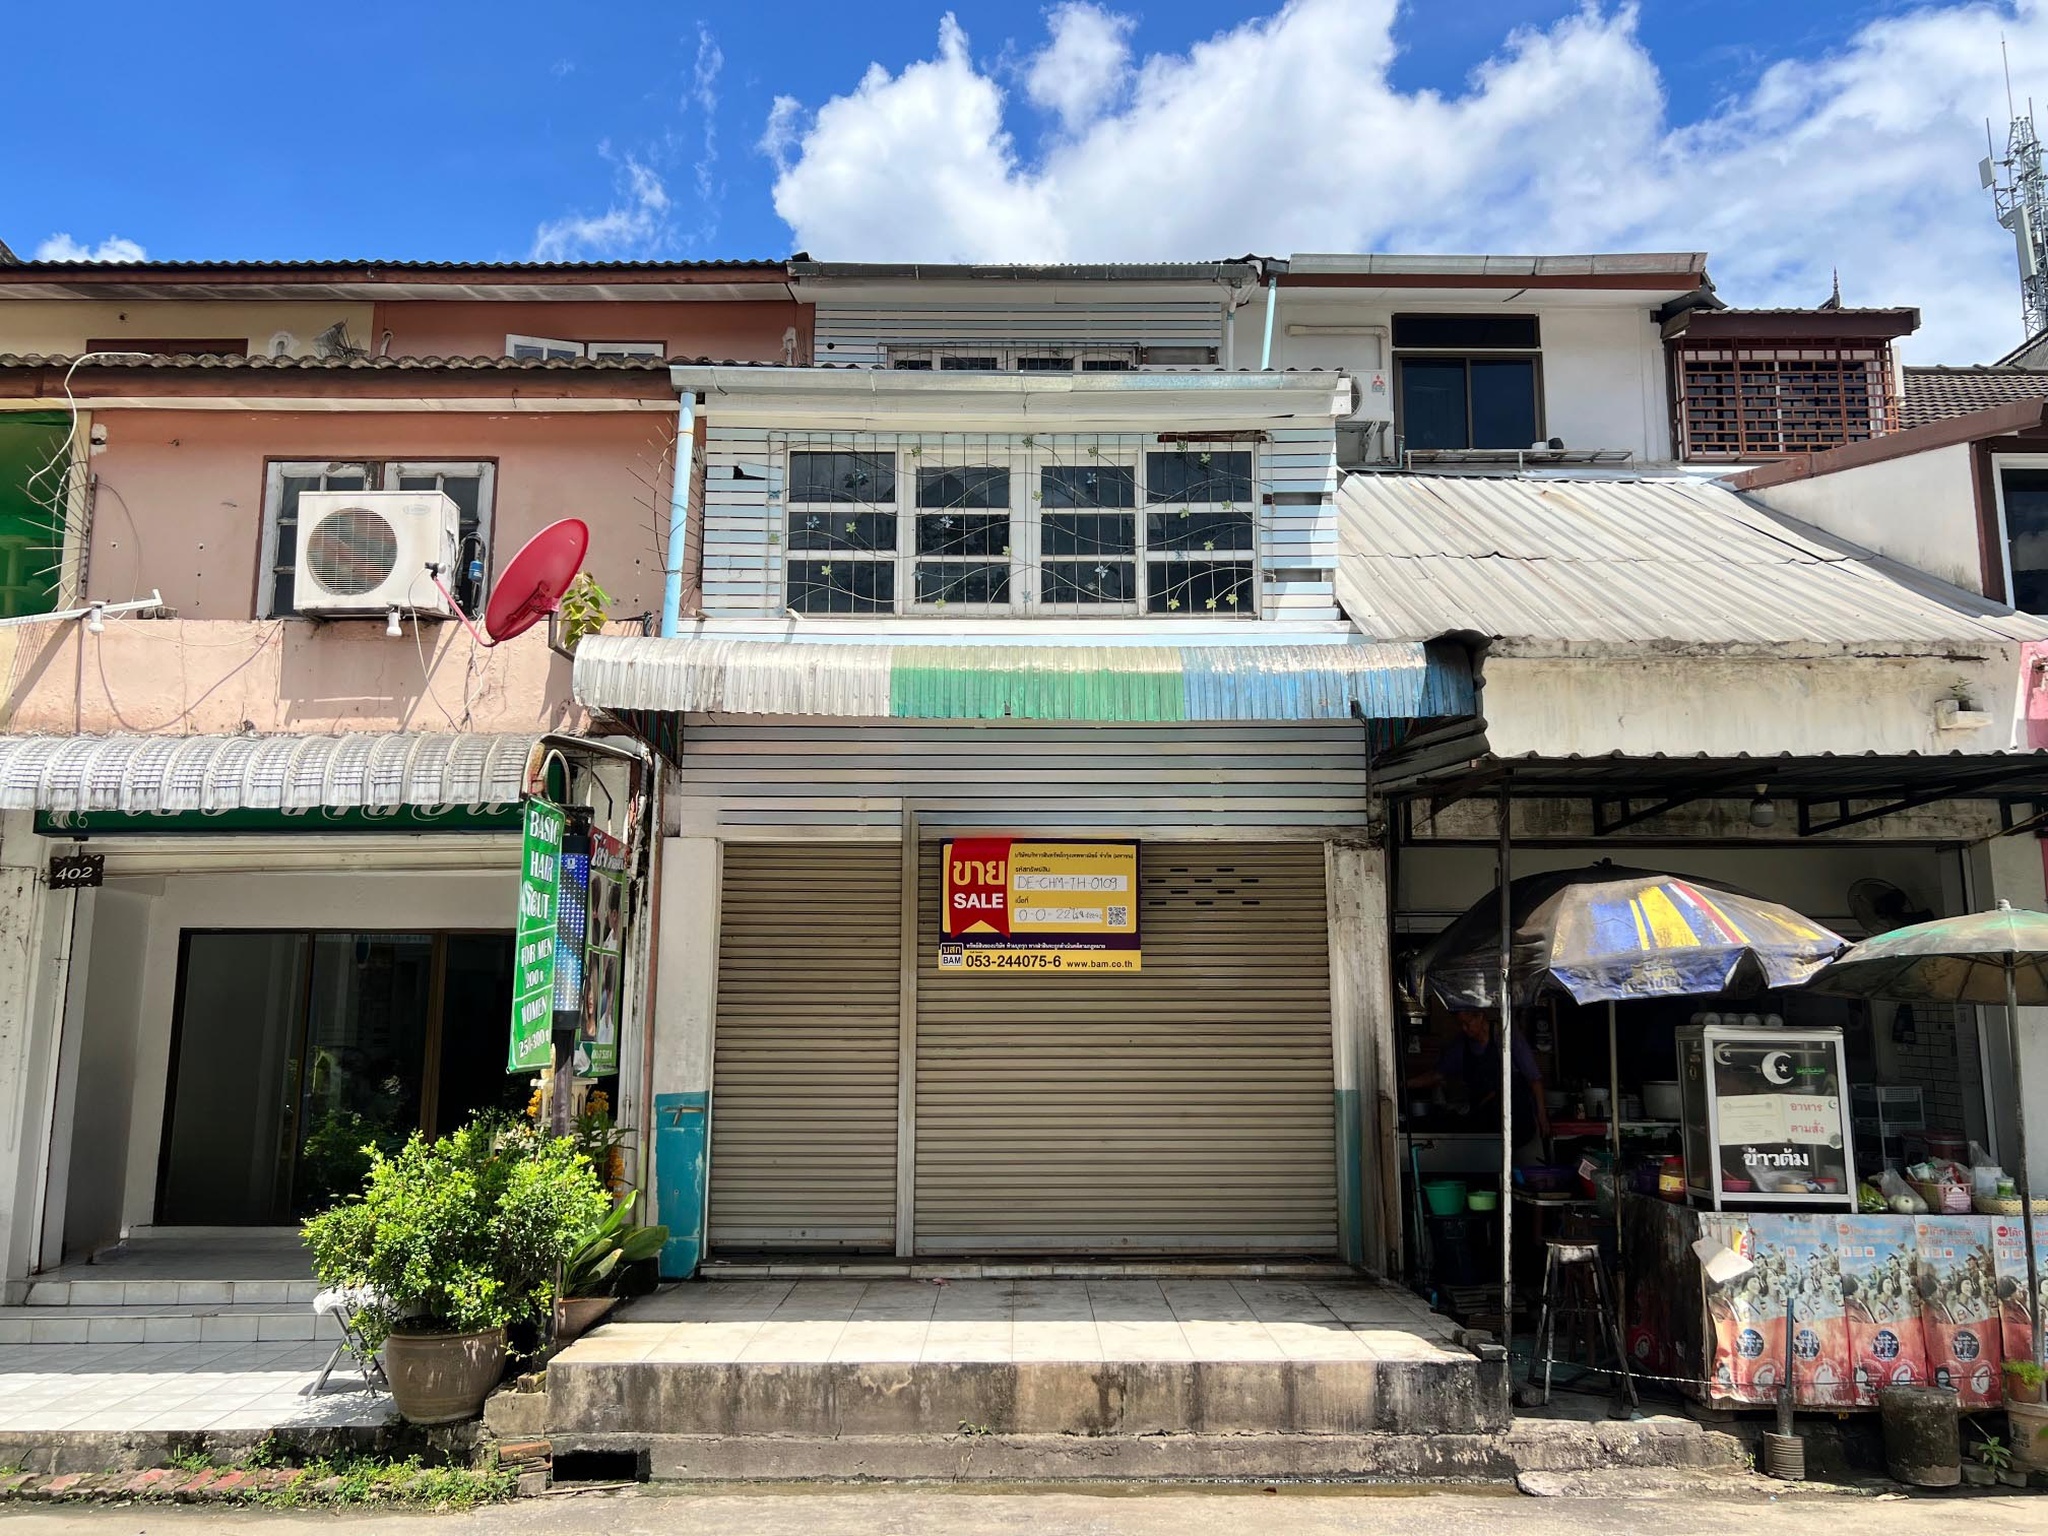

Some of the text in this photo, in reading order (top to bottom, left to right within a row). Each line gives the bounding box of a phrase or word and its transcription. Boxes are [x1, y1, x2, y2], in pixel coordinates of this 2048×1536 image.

[529, 810, 560, 845] BASIC
[55, 866, 93, 880] 402
[530, 850, 554, 882] HAIR
[953, 860, 1005, 886] ขาย
[530, 890, 550, 919] CUT
[953, 892, 1004, 909] SALE
[520, 937, 552, 968] FOR MEN
[942, 945, 962, 954] บสก
[943, 956, 962, 965] BAM
[966, 954, 1133, 968] 053-244075-6 www.bam.co.th
[525, 969, 539, 988] 200
[521, 995, 548, 1026] WOMEN
[1789, 1102, 1823, 1112] อาหาร
[1790, 1119, 1825, 1134] ตามสั่ง
[1743, 1147, 1809, 1167] ข้าวต้ม
